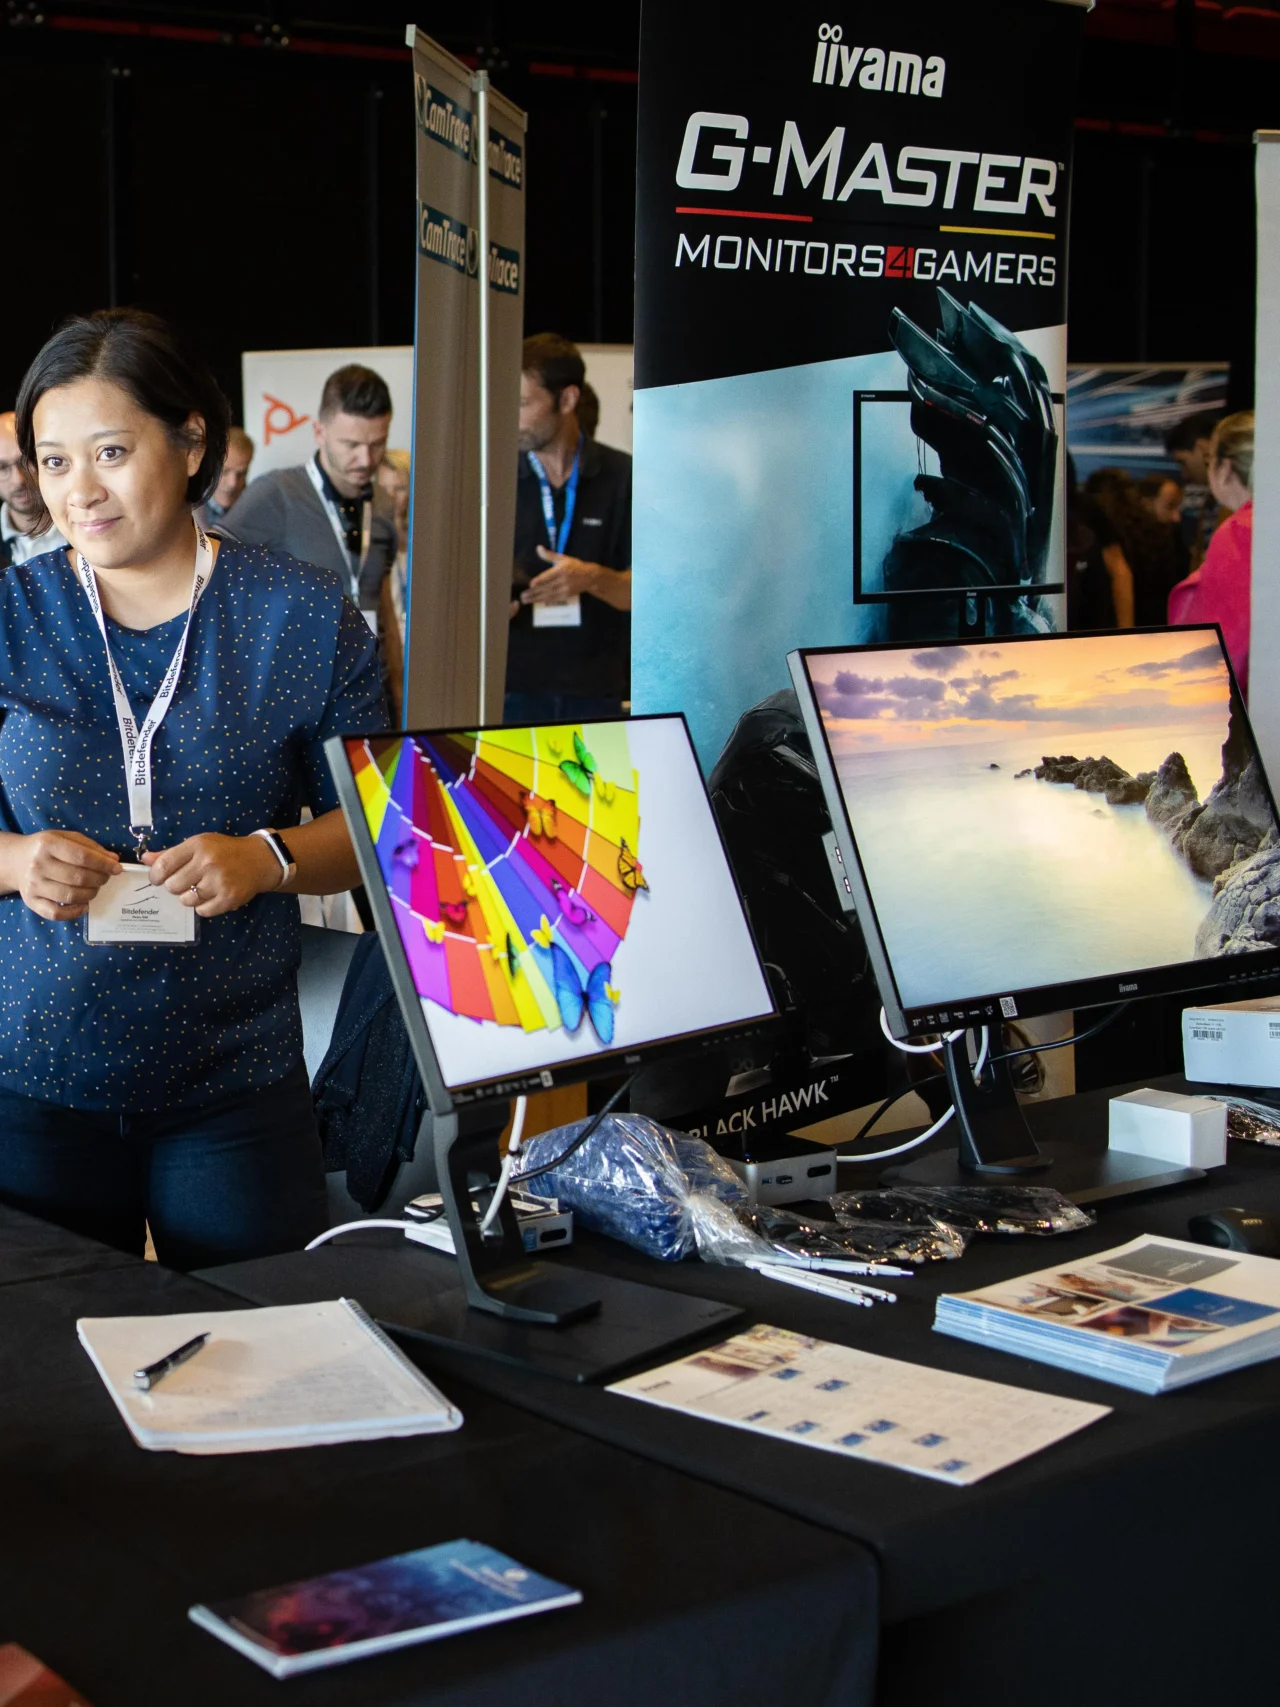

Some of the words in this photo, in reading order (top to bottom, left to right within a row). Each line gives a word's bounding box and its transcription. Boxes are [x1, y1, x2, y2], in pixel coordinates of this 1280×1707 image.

[812, 23, 946, 98] iiyama
[675, 111, 1057, 218] G-MASTER
[674, 233, 1057, 287] MONITORS4GAMERS
[135, 719, 157, 787] Bitdefender
[121, 908, 160, 916] Bitdefender
[761, 1080, 830, 1124] HAWK
